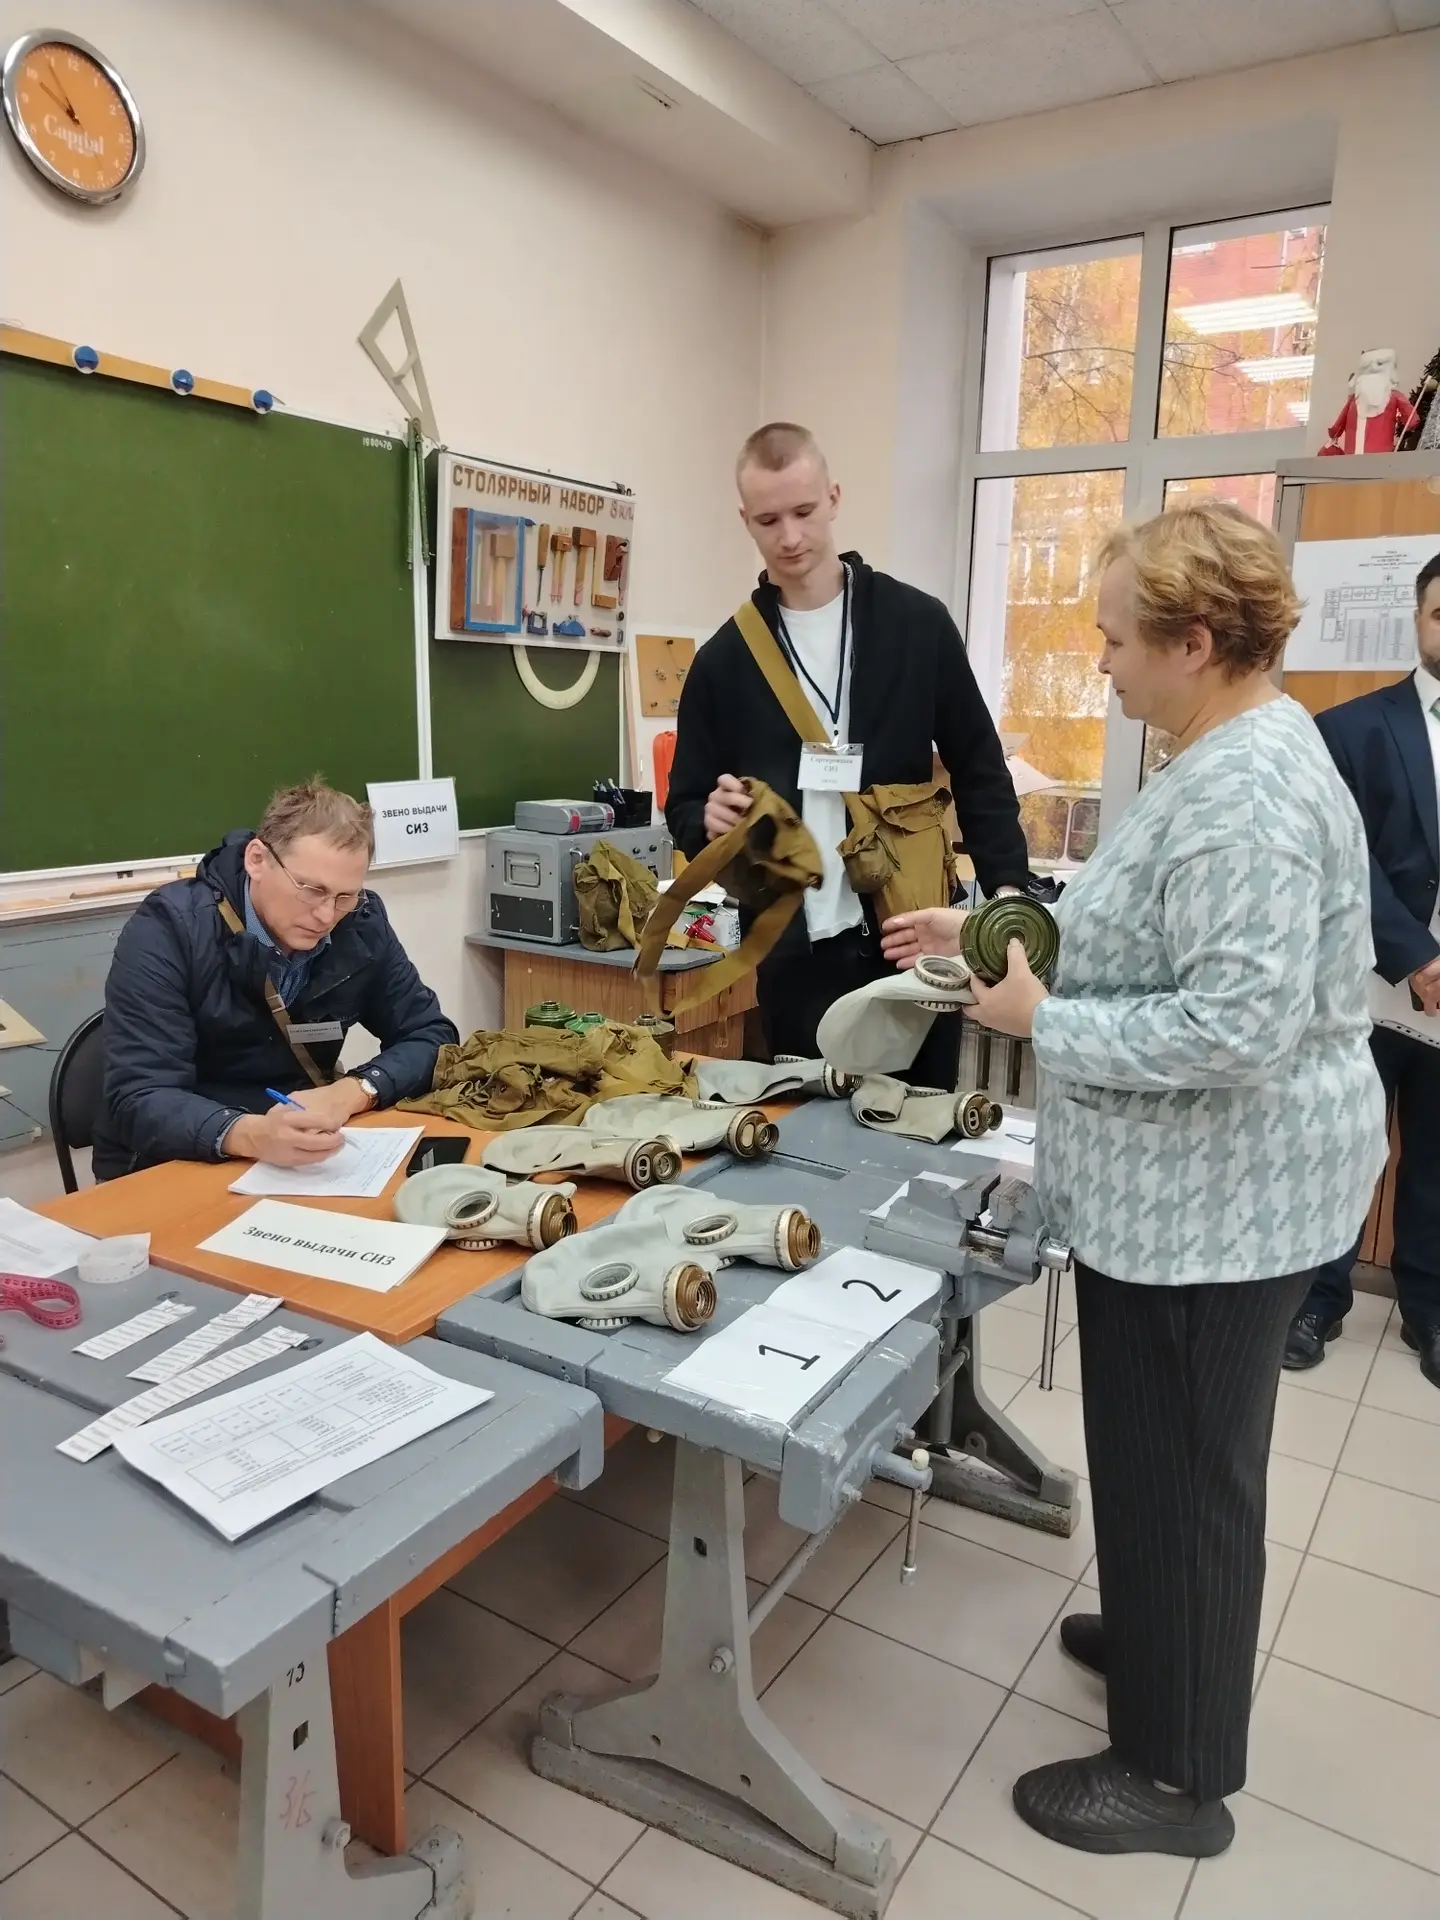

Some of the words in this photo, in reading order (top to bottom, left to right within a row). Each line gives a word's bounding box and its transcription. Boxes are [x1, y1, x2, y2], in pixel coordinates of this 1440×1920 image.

[43, 114, 104, 155] Capital
[452, 464, 551, 505] СТОЛЯРНЫЙ
[559, 489, 605, 516] НАБОР
[382, 807, 410, 818] ЗВЕНО
[412, 804, 448, 816] ВЫДАЧИ
[406, 822, 429, 835] СИЗ
[243, 1226, 292, 1244] Звено
[292, 1238, 358, 1258] выдачи
[360, 1251, 396, 1267] СИЗ
[842, 1279, 903, 1303] 2
[758, 1344, 821, 1371] 1
